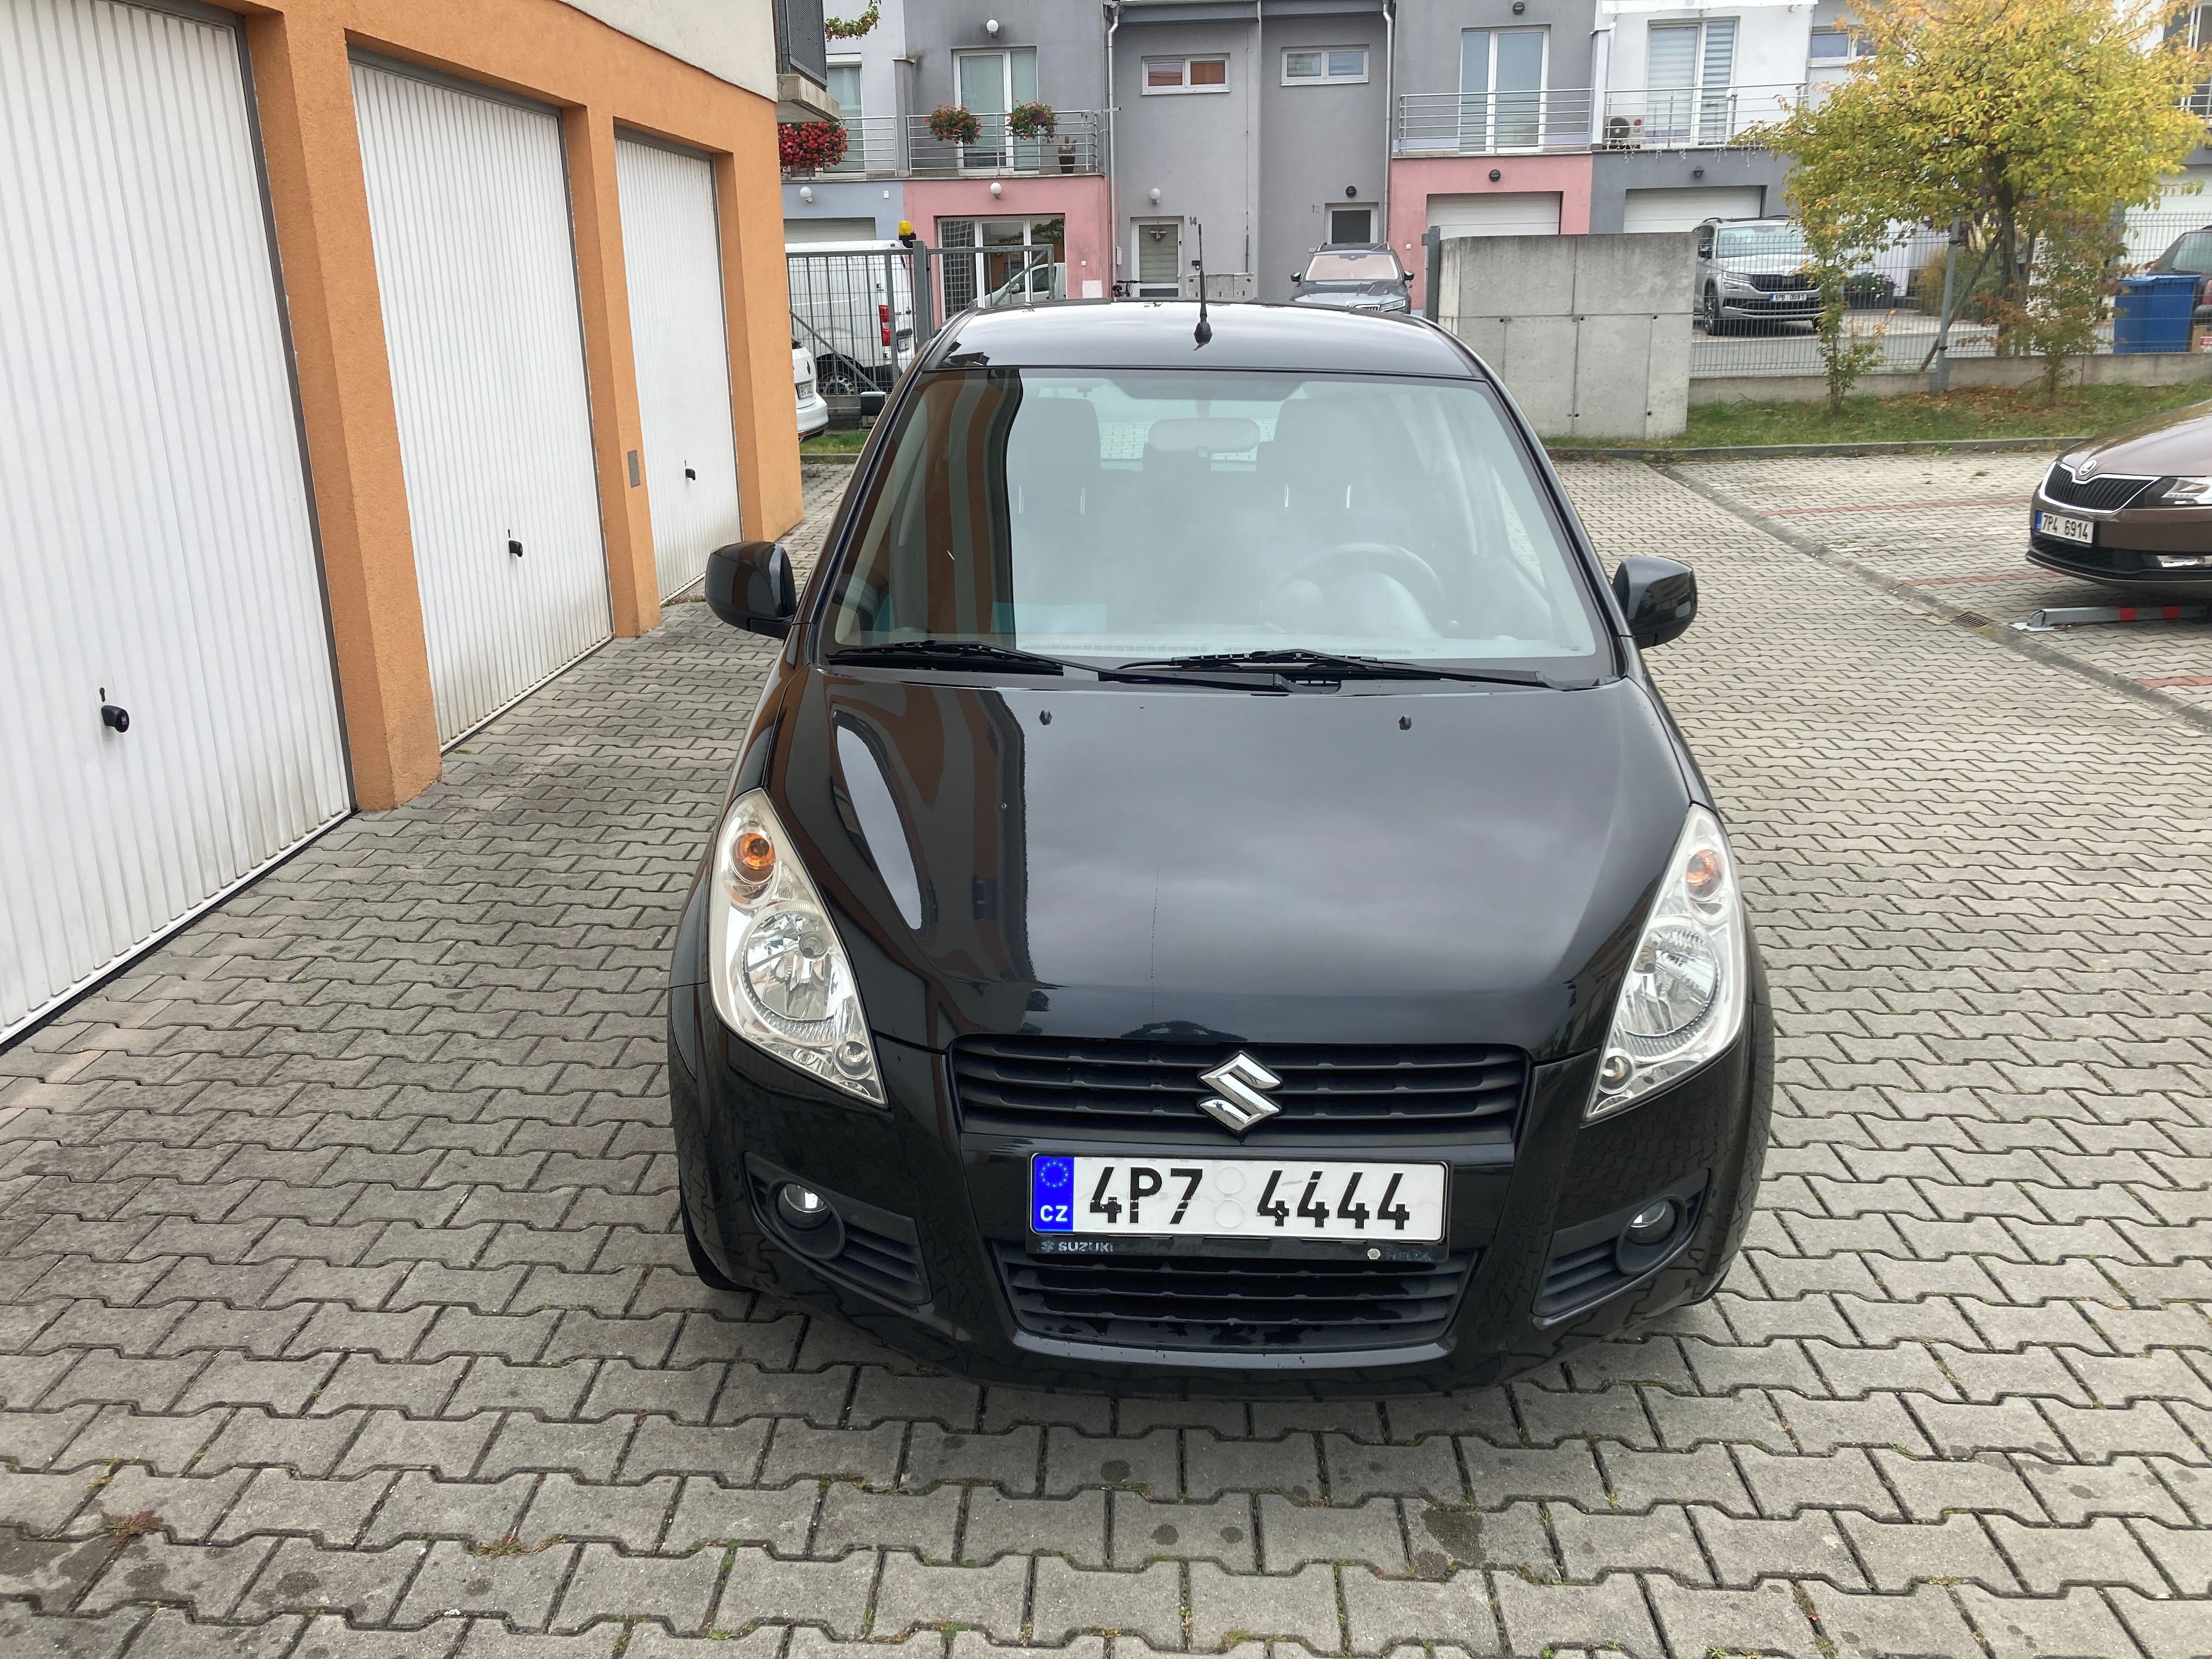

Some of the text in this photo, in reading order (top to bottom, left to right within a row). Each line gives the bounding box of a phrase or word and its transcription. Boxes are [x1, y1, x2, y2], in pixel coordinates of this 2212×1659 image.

[1189, 216, 1197, 225] 14
[2042, 515, 2088, 540] 7P4 6914
[1090, 1166, 1410, 1230] 4P7 4444
[1040, 1205, 1068, 1222] CZ
[1058, 1242, 1114, 1252] SUZUKI
